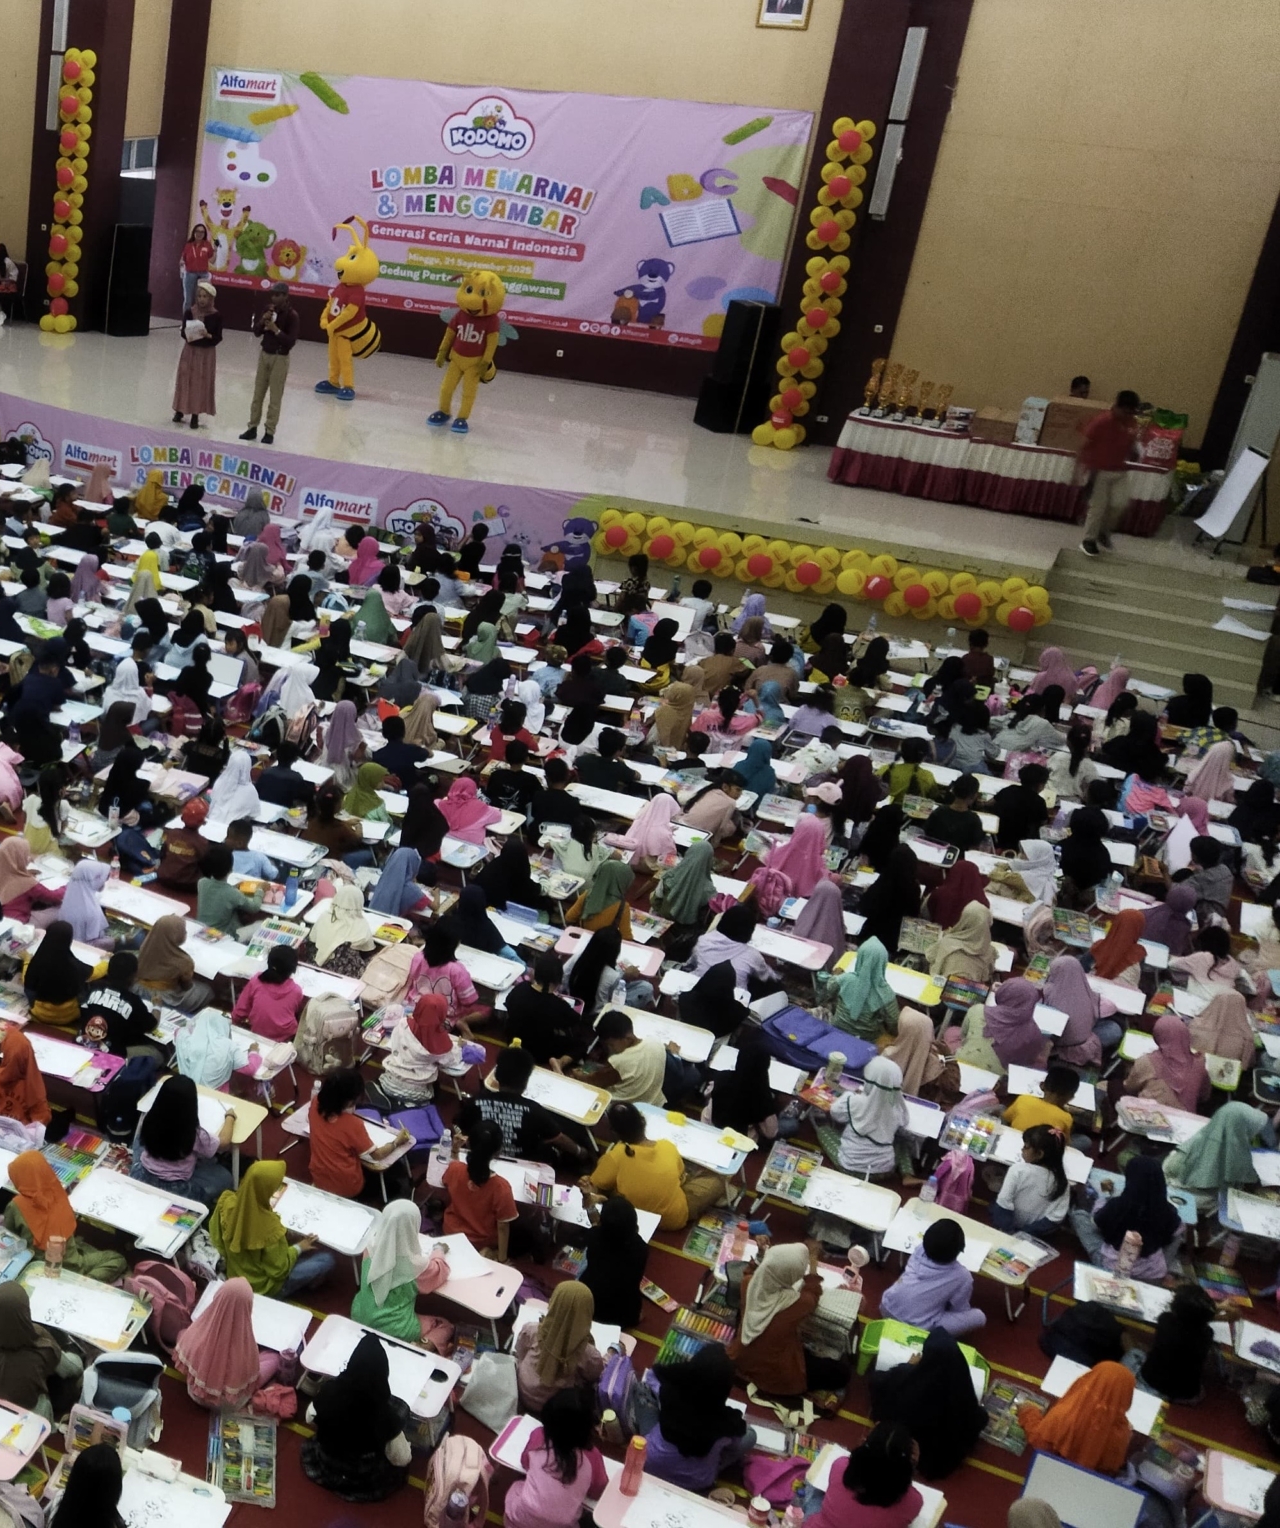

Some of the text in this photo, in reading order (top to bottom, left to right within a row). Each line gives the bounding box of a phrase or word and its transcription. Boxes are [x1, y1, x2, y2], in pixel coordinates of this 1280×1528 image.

[220, 74, 277, 91] Alfamart
[450, 127, 527, 151] KODOMO
[370, 164, 595, 211] LOMBA MEWARNAI
[376, 193, 578, 237] & MENGGAMBAR
[371, 223, 578, 258] Generasi Ceria Warnai Indonesia
[379, 264, 421, 281] Gedung
[456, 258, 506, 274] September
[456, 322, 486, 345] Albi
[65, 443, 118, 468] Alfamart
[131, 446, 296, 495] LOMBA MEWARNAI
[162, 470, 284, 513] ENGGAMR
[303, 492, 373, 516] Alfamart
[87, 990, 133, 1020] MARIO
